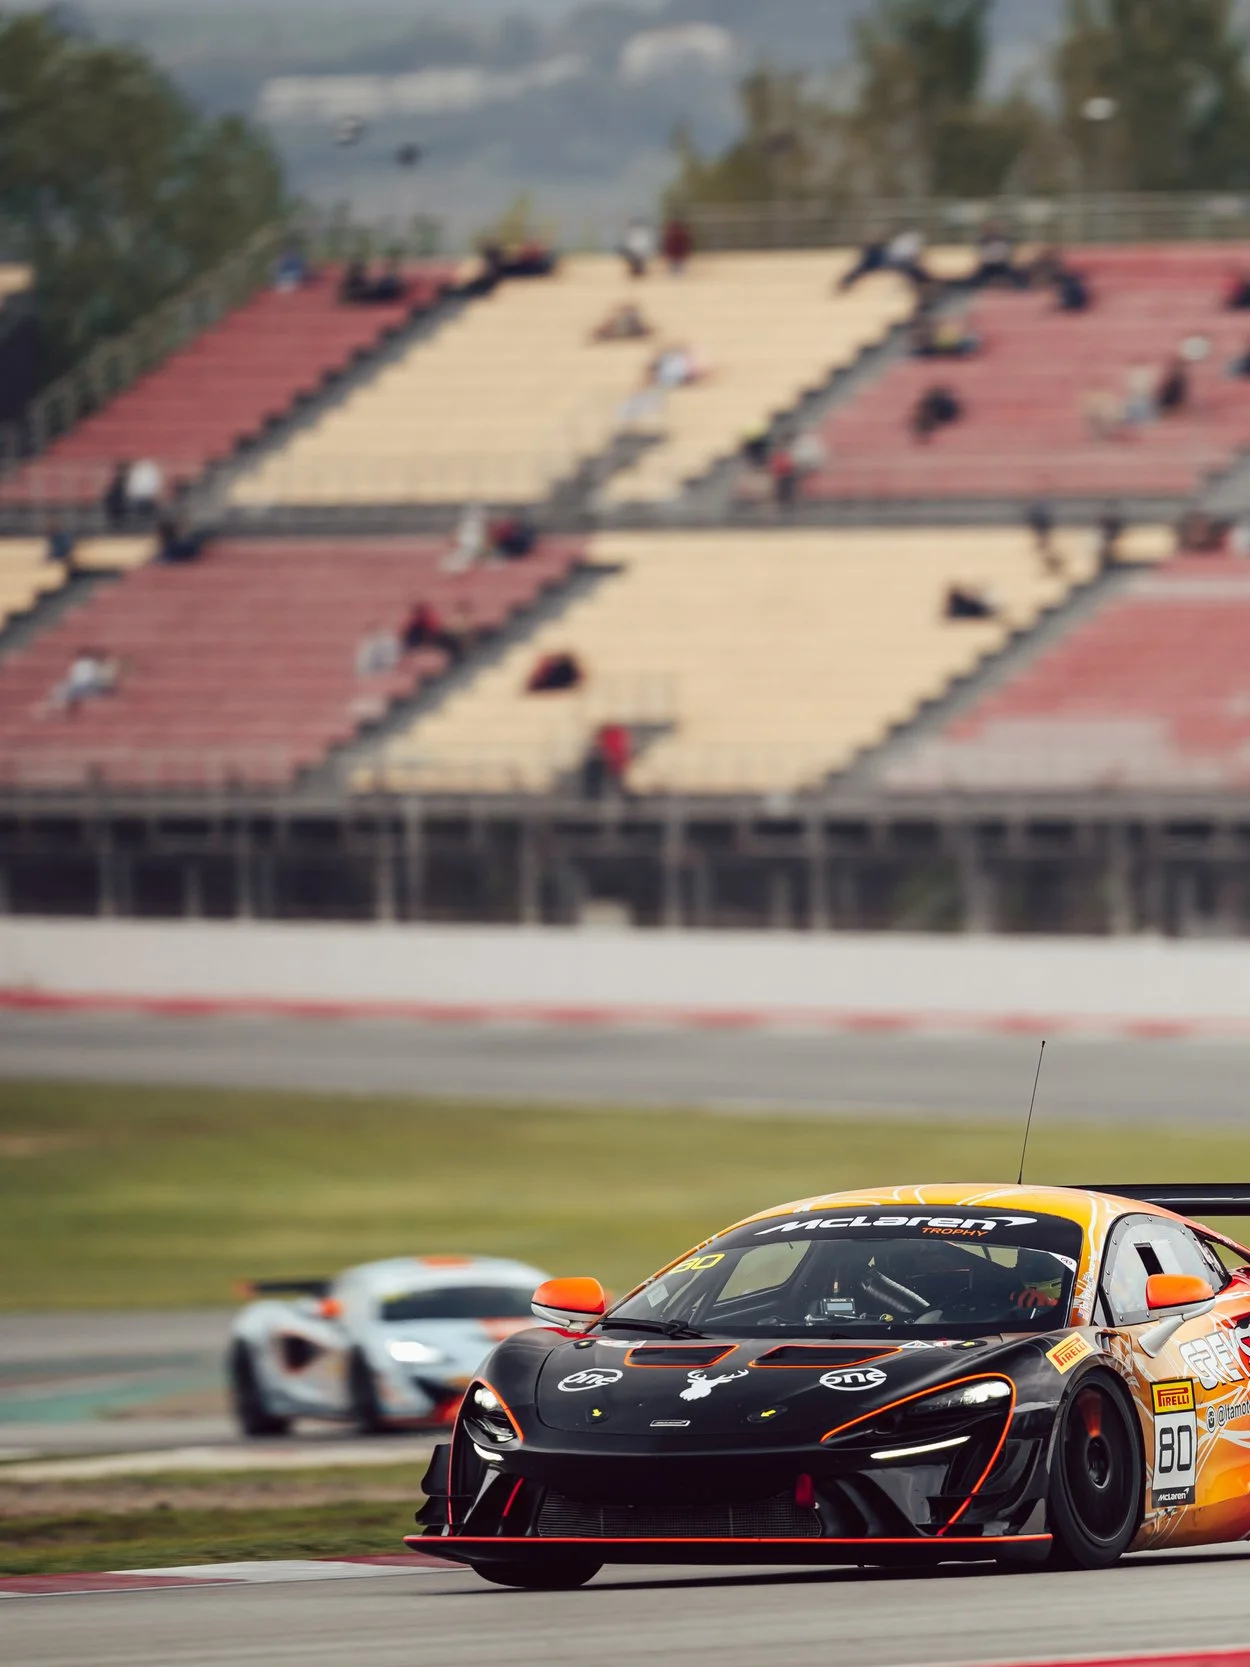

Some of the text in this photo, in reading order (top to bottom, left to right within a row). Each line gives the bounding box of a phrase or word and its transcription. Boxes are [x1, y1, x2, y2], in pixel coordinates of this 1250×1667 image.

[754, 1216, 999, 1235] McLaren
[922, 1227, 988, 1237] TROPHY
[1052, 1337, 1087, 1367] PIRELLI
[560, 1370, 620, 1387] one
[819, 1370, 887, 1387] one
[1157, 1387, 1190, 1407] PIRELLI
[1159, 1424, 1193, 1474] 80
[1158, 1492, 1187, 1502] McLaren
